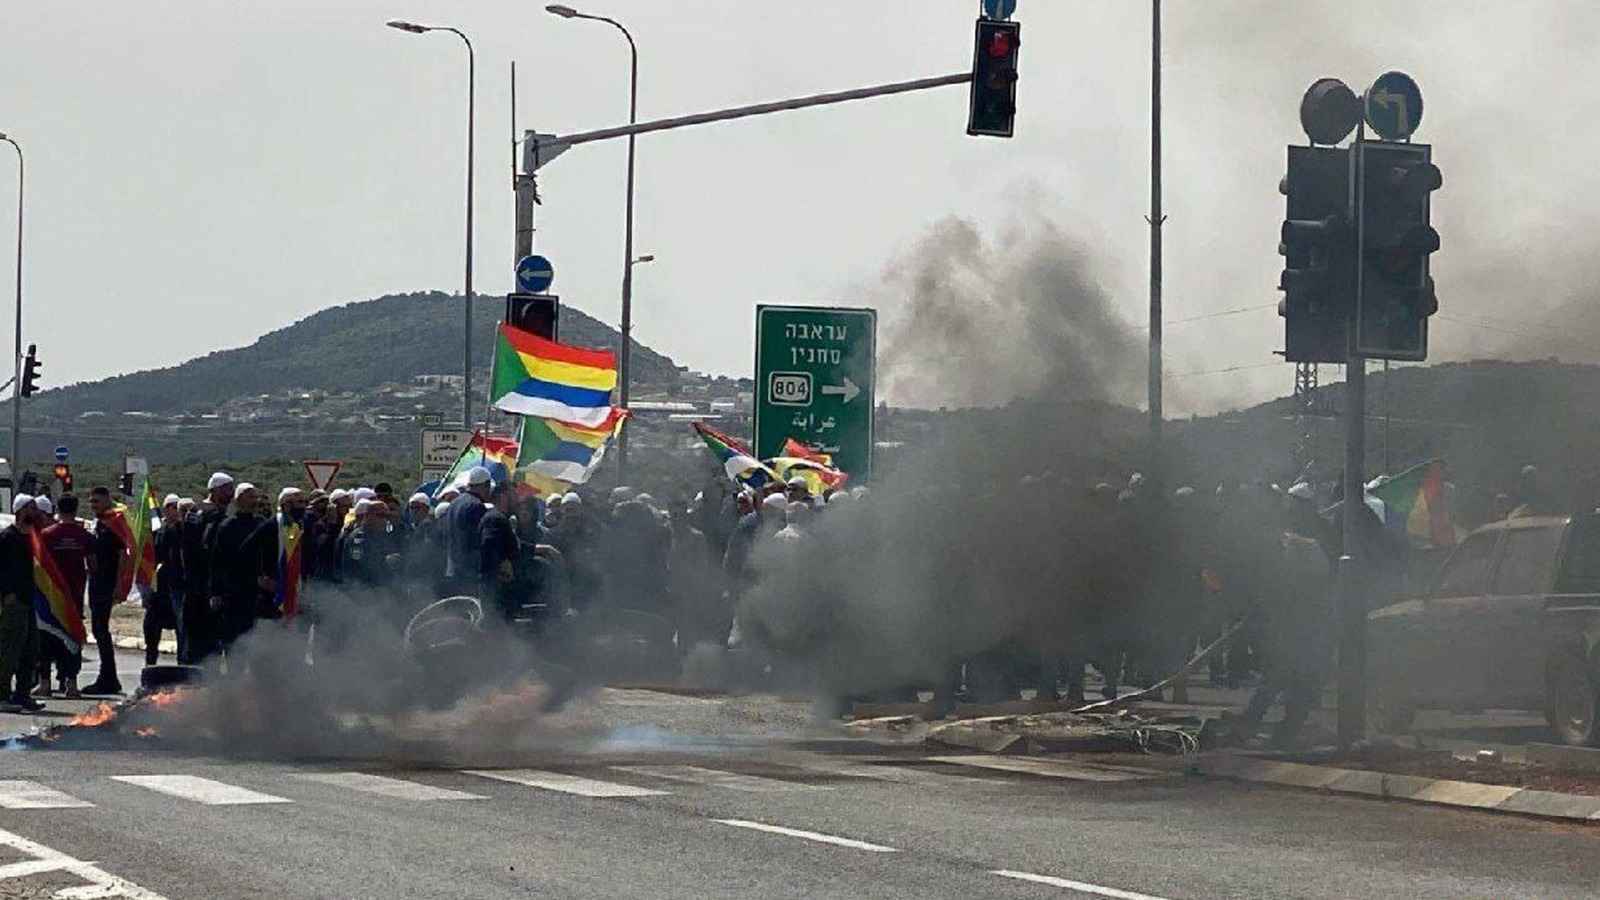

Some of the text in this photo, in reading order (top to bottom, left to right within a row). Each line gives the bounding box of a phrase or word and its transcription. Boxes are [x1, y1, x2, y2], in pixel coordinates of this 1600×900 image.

[785, 324, 848, 341] עראבה
[790, 347, 841, 365] סחנין
[775, 381, 808, 396] 804
[791, 411, 836, 433] عرابة
